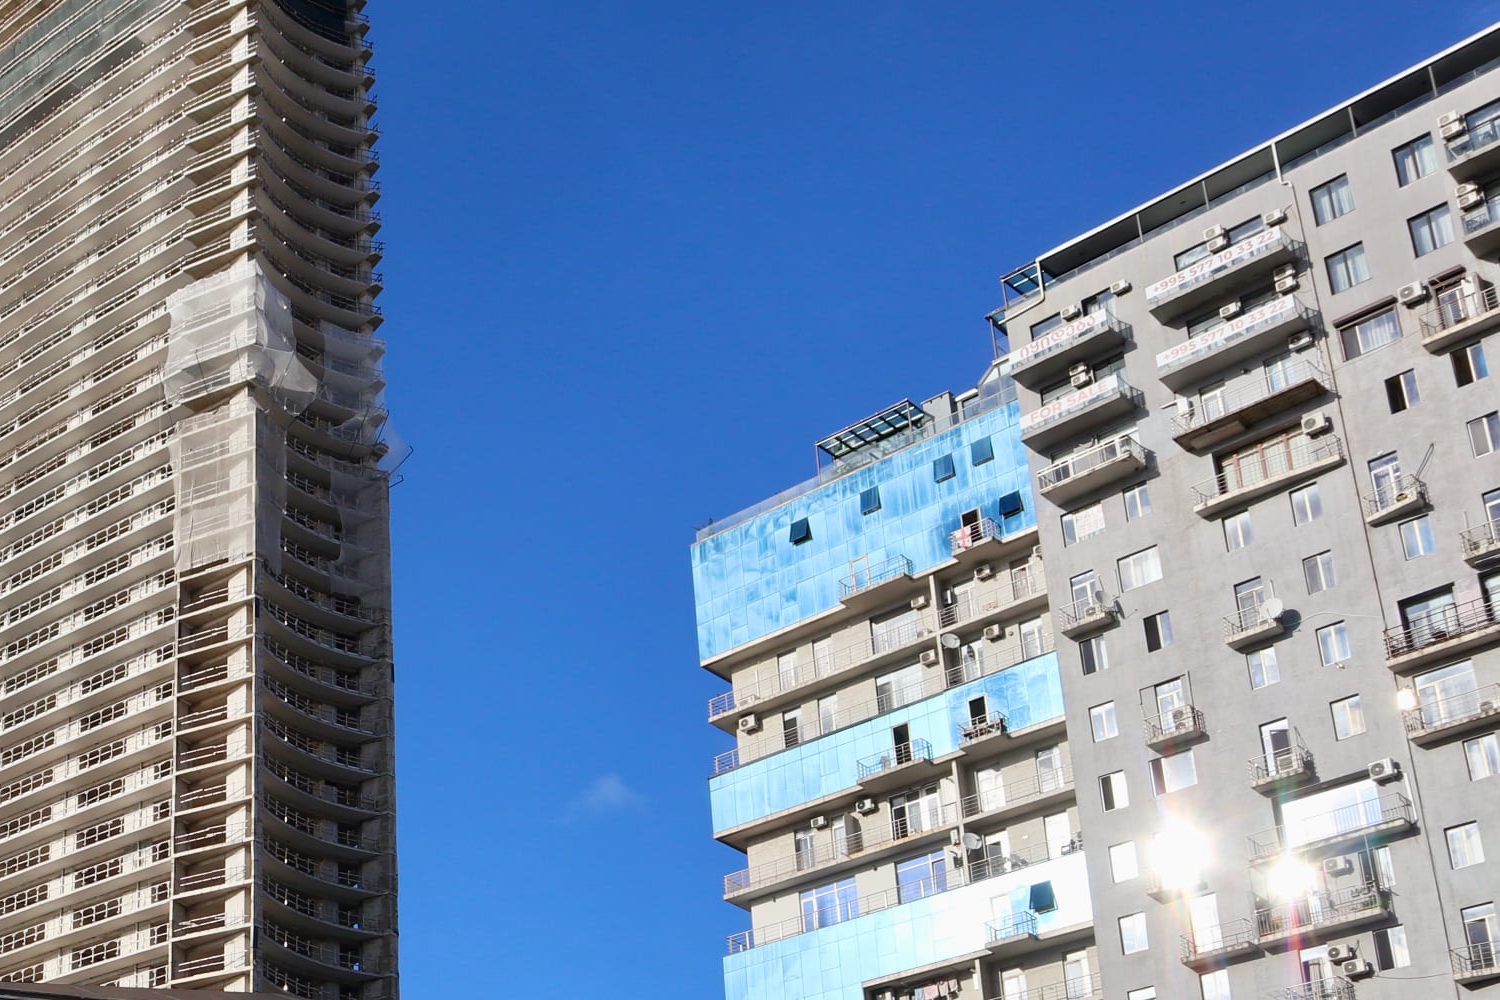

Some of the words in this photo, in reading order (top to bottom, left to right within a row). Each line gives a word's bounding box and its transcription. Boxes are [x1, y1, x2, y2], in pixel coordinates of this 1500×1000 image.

[1154, 273, 1186, 293] +995
[1189, 260, 1214, 277] 577
[1218, 250, 1233, 263] 10
[1236, 241, 1253, 255] 33
[1259, 231, 1275, 244] 22
[1201, 328, 1225, 345] 577
[1229, 319, 1244, 332] 10
[1250, 310, 1266, 322] 33
[1270, 300, 1286, 313] 22
[1029, 402, 1063, 423] FOR
[1067, 380, 1109, 403] SALE
